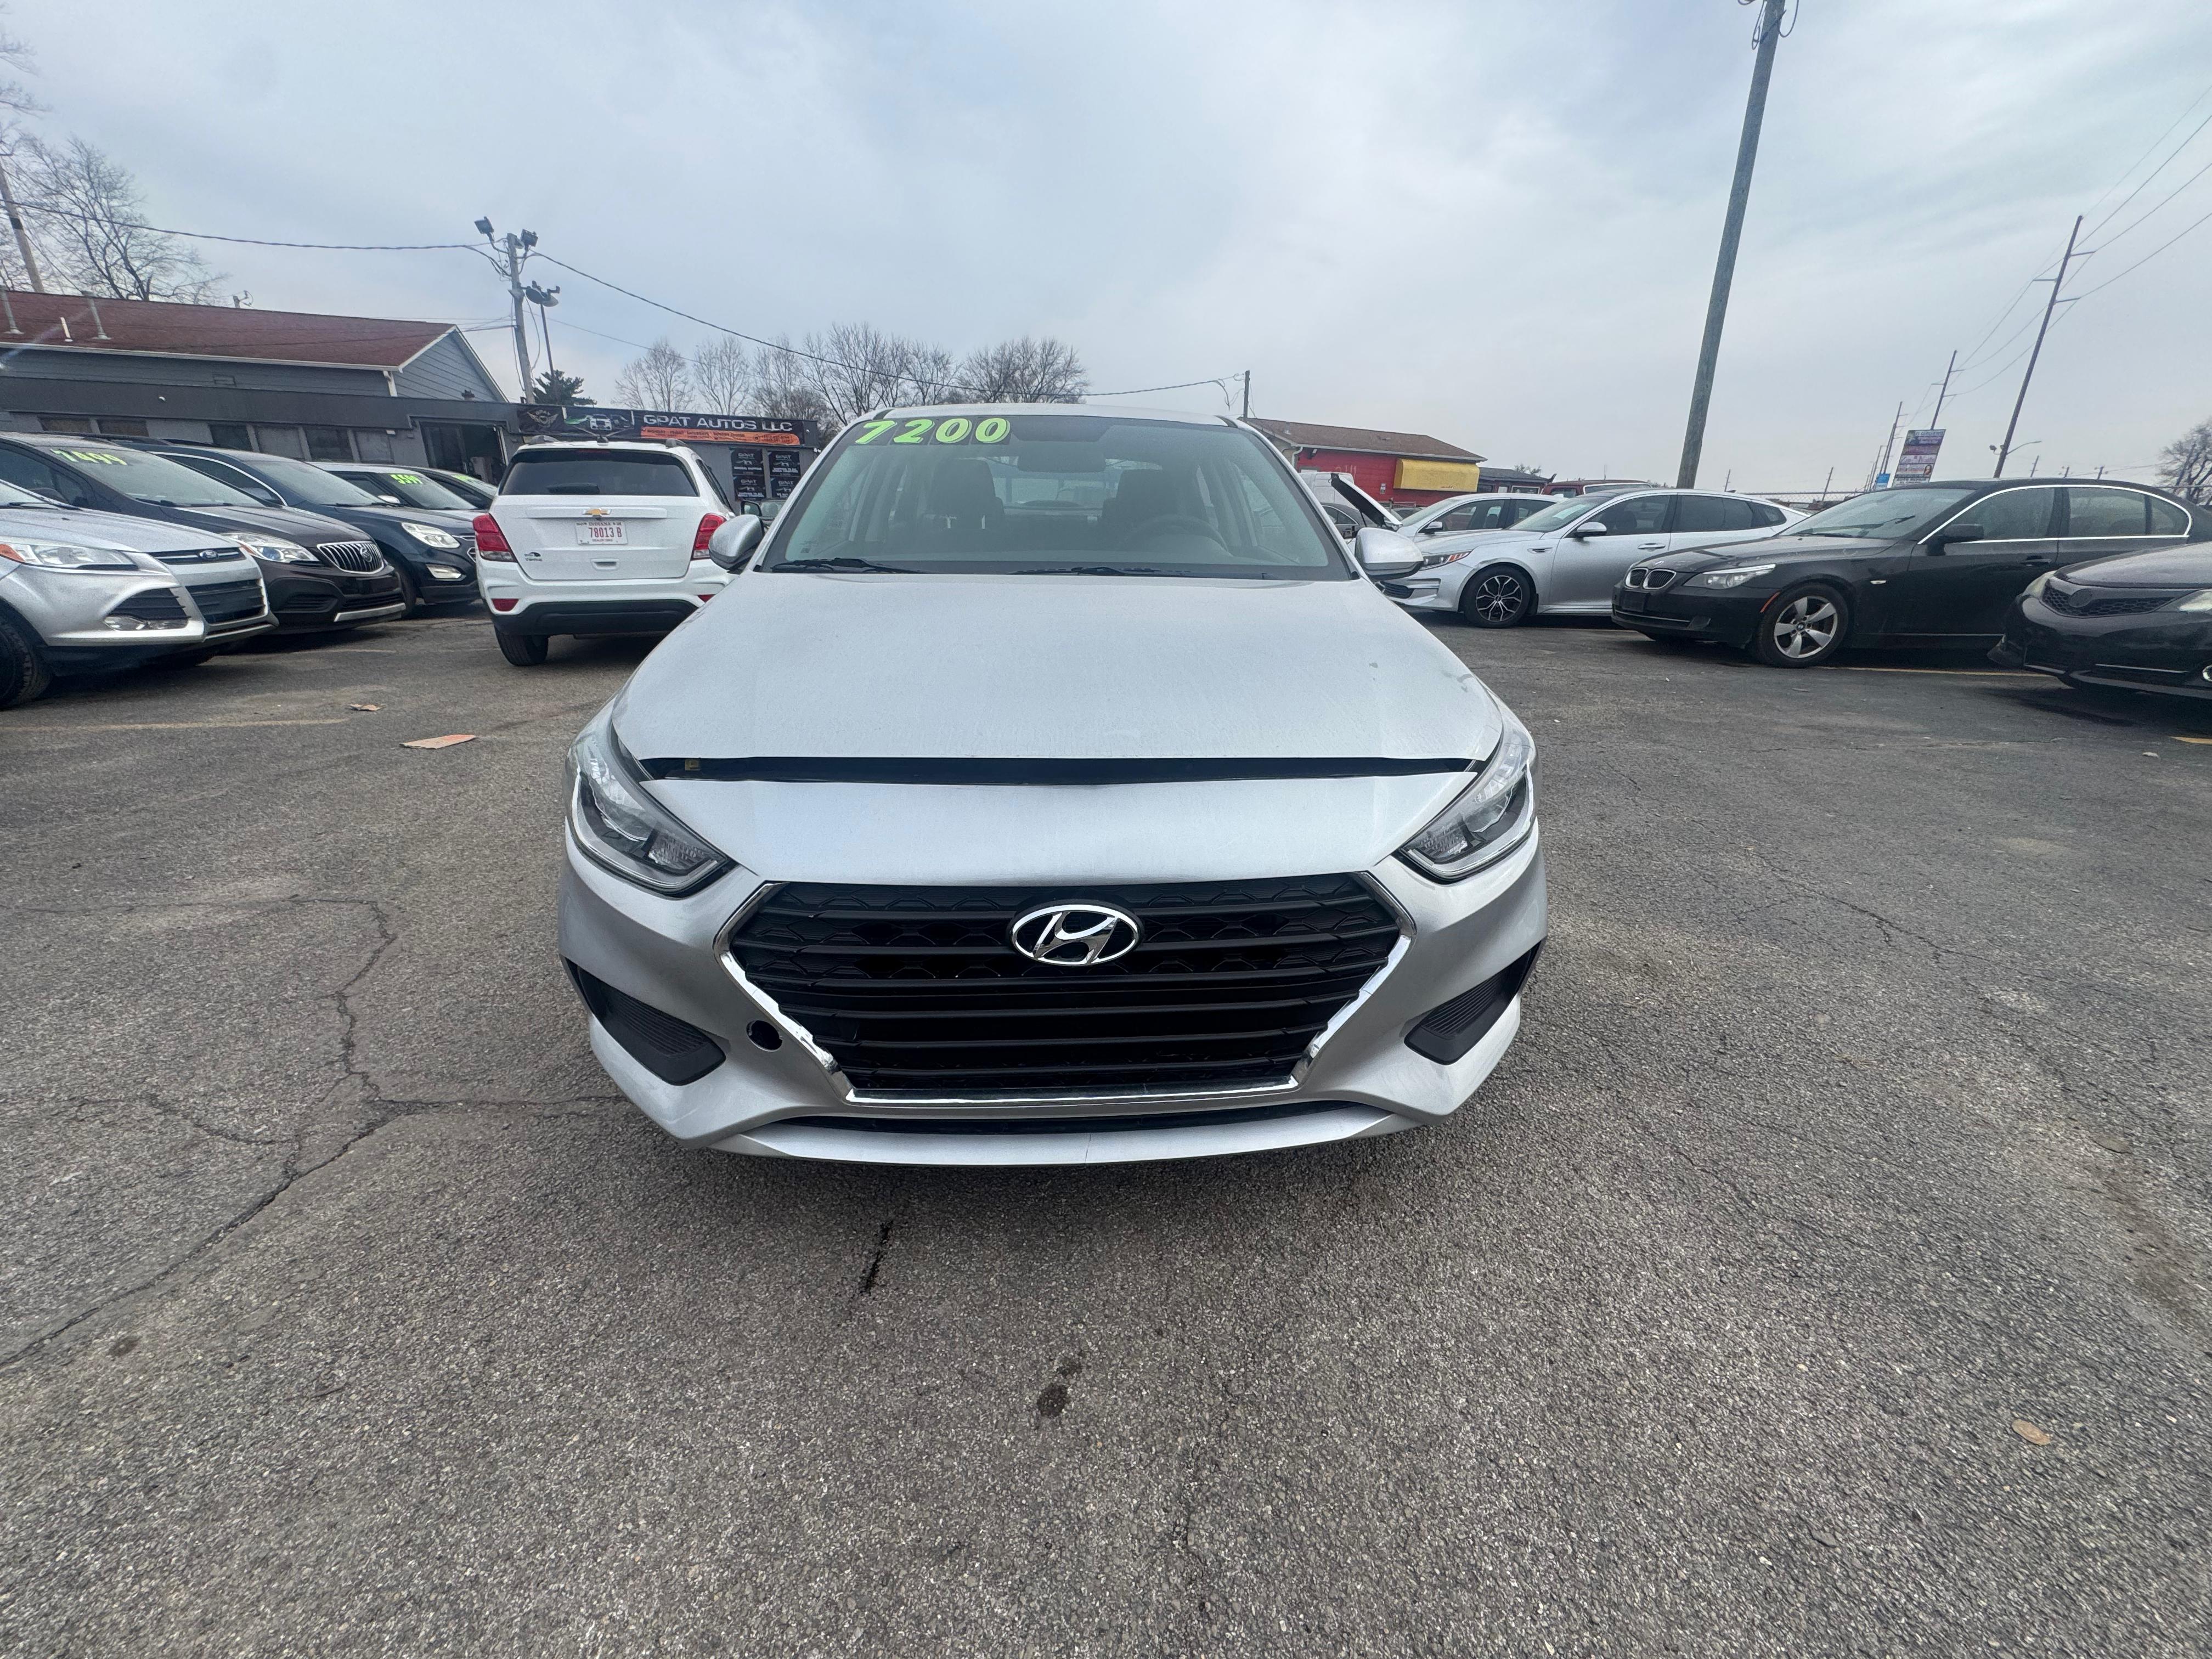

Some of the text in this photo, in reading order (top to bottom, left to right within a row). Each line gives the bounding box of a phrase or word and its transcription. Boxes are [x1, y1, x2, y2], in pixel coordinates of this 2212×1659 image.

[644, 415, 793, 431] GPAT AUTOS LLC
[855, 417, 1011, 444] 7200
[588, 527, 623, 538] 78013 B
